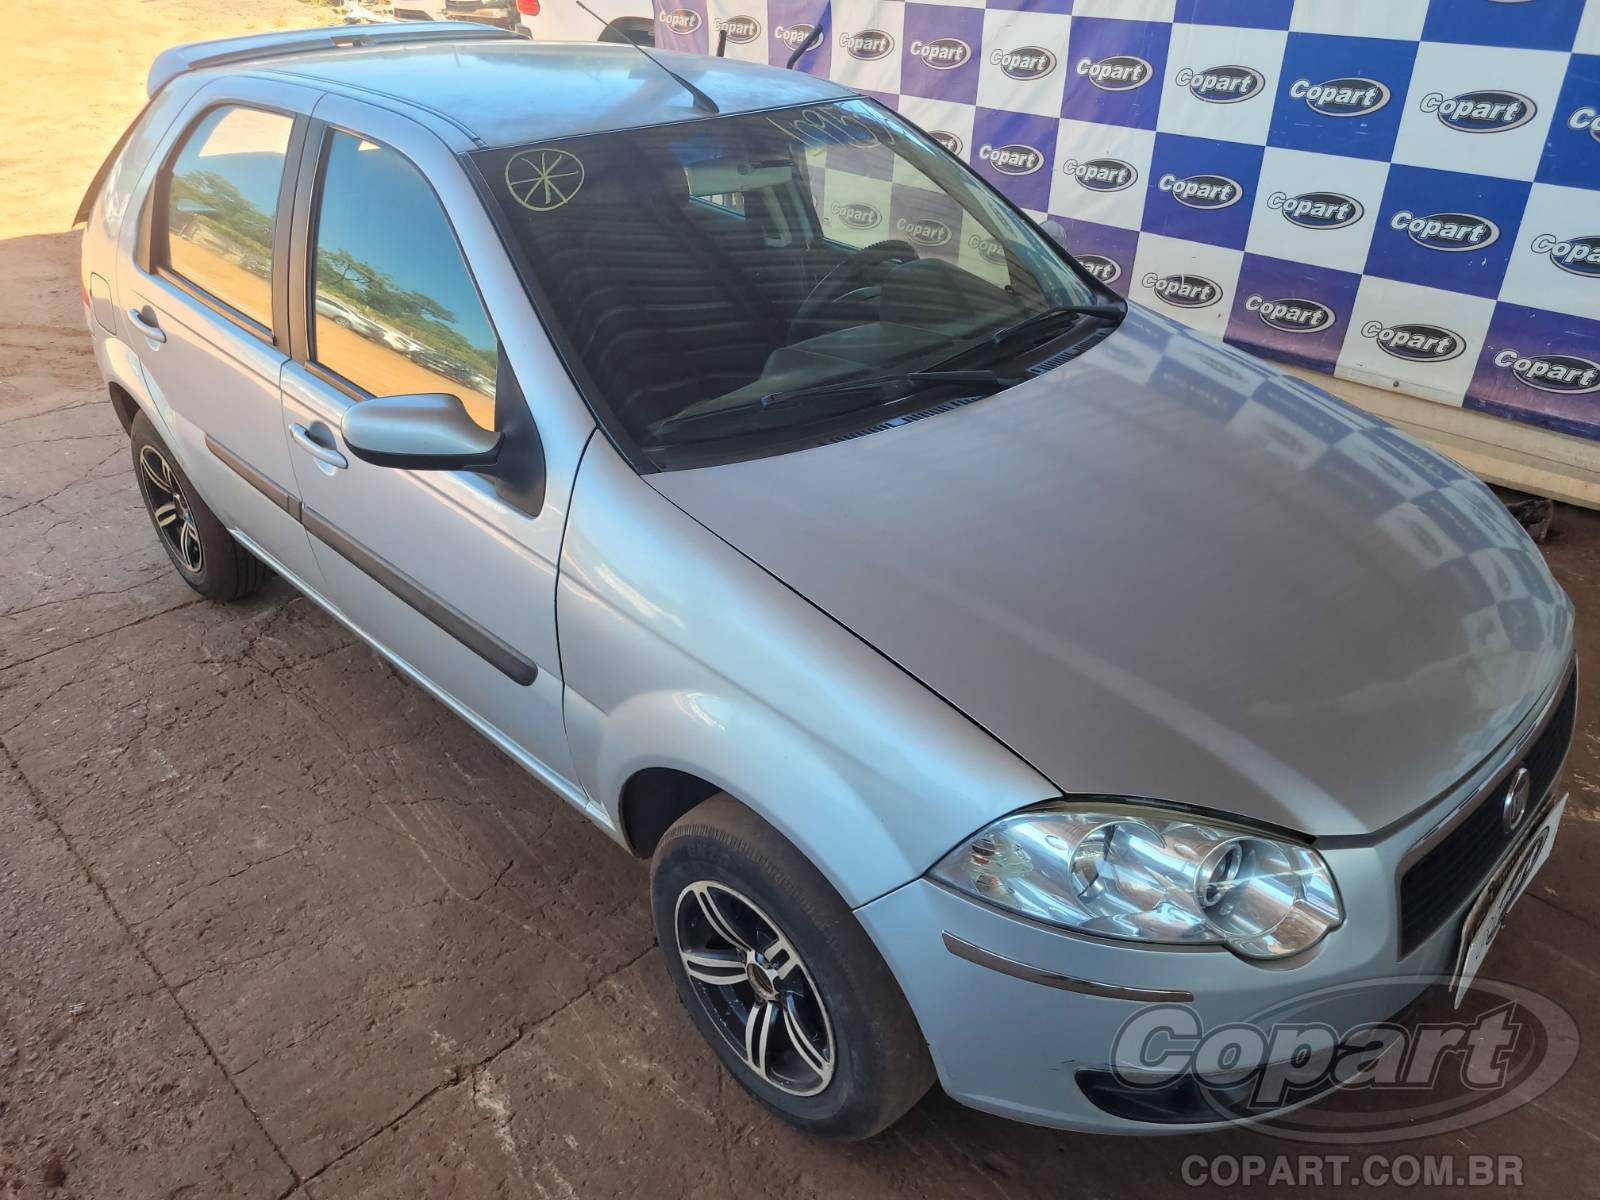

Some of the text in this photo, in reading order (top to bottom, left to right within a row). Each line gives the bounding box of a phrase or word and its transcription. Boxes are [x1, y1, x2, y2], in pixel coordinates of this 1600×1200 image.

[713, 18, 753, 36] Copart
[839, 32, 889, 53] Copart
[911, 41, 963, 61] Copart
[990, 49, 1046, 70] Copart
[1076, 58, 1143, 82] Copart
[1176, 68, 1252, 94] Copart
[1290, 79, 1377, 106] Copart
[1420, 93, 1520, 121] Copart
[979, 144, 1036, 167] Copart
[1063, 159, 1130, 183] Copart
[1159, 174, 1234, 200] Copart
[831, 202, 875, 224] Copart
[1267, 192, 1352, 220] Copart
[896, 218, 944, 241] Copart
[1391, 211, 1486, 243] Copart
[1531, 234, 1600, 263] Copa
[1142, 272, 1212, 300] Copart
[1245, 295, 1326, 326] Copart
[1361, 321, 1454, 355] Copart
[1494, 349, 1600, 386] Copart
